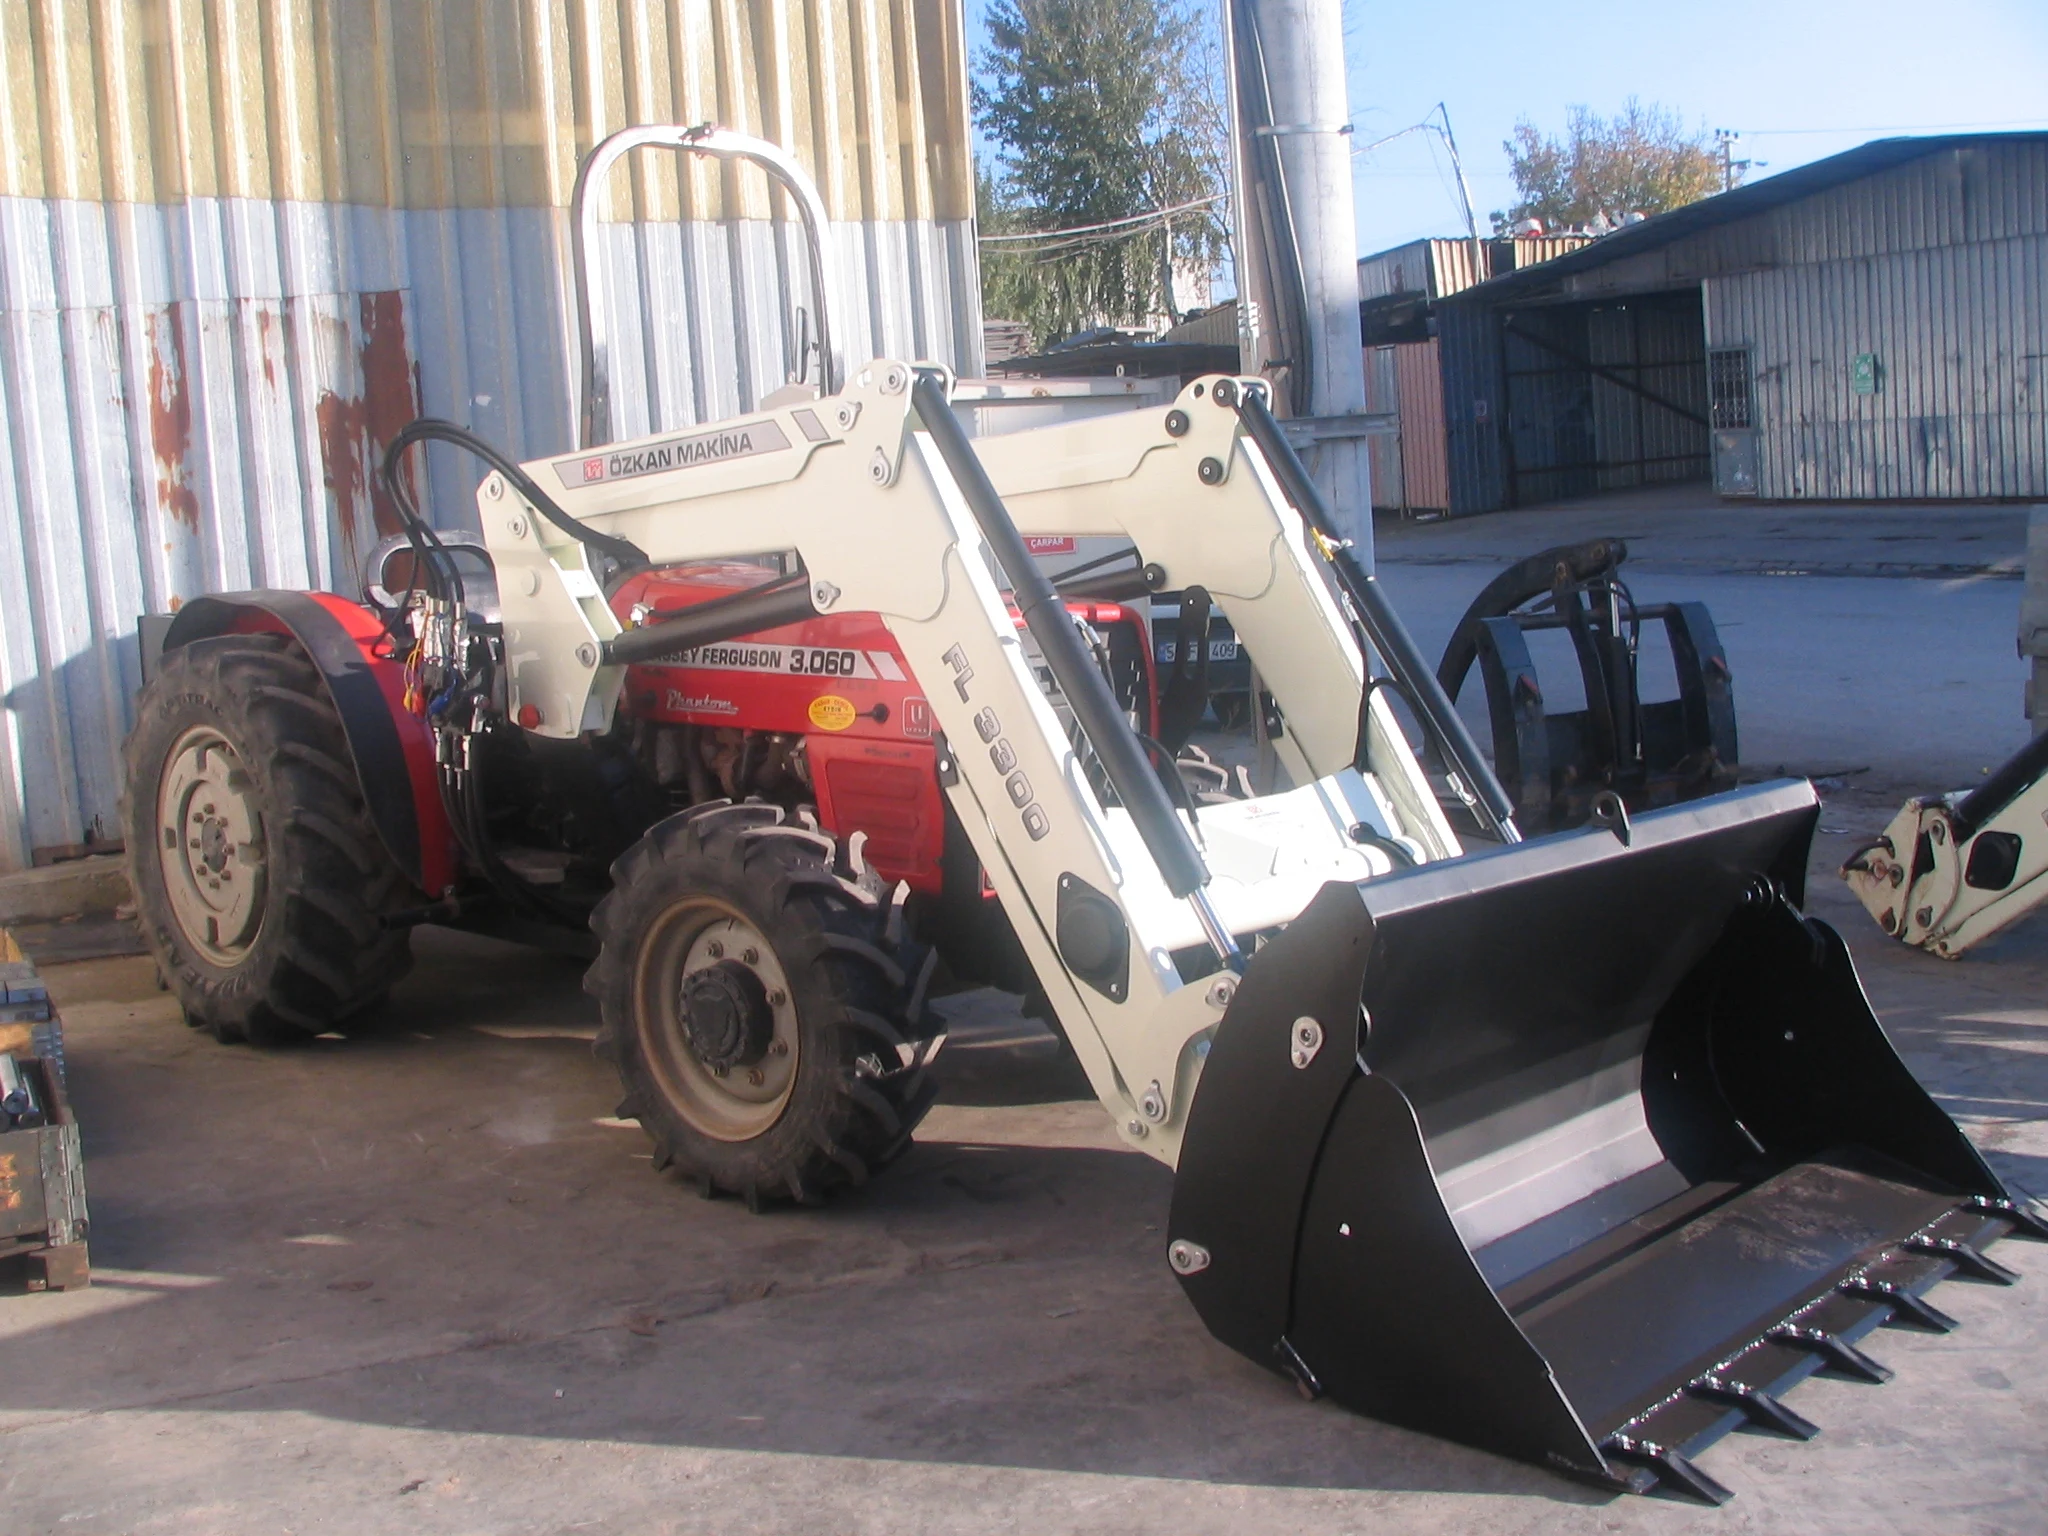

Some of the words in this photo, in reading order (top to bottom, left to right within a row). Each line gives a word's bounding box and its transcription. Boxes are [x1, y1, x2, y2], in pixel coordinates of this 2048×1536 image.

[609, 448, 671, 476] ÖZKAN
[676, 432, 753, 465] MAKİNA
[702, 648, 782, 668] FERGUSON
[789, 649, 856, 676] 3.060
[1212, 643, 1235, 657] 409
[666, 688, 739, 715] Phantom
[941, 642, 975, 704] FL
[973, 706, 1050, 842] 3300
